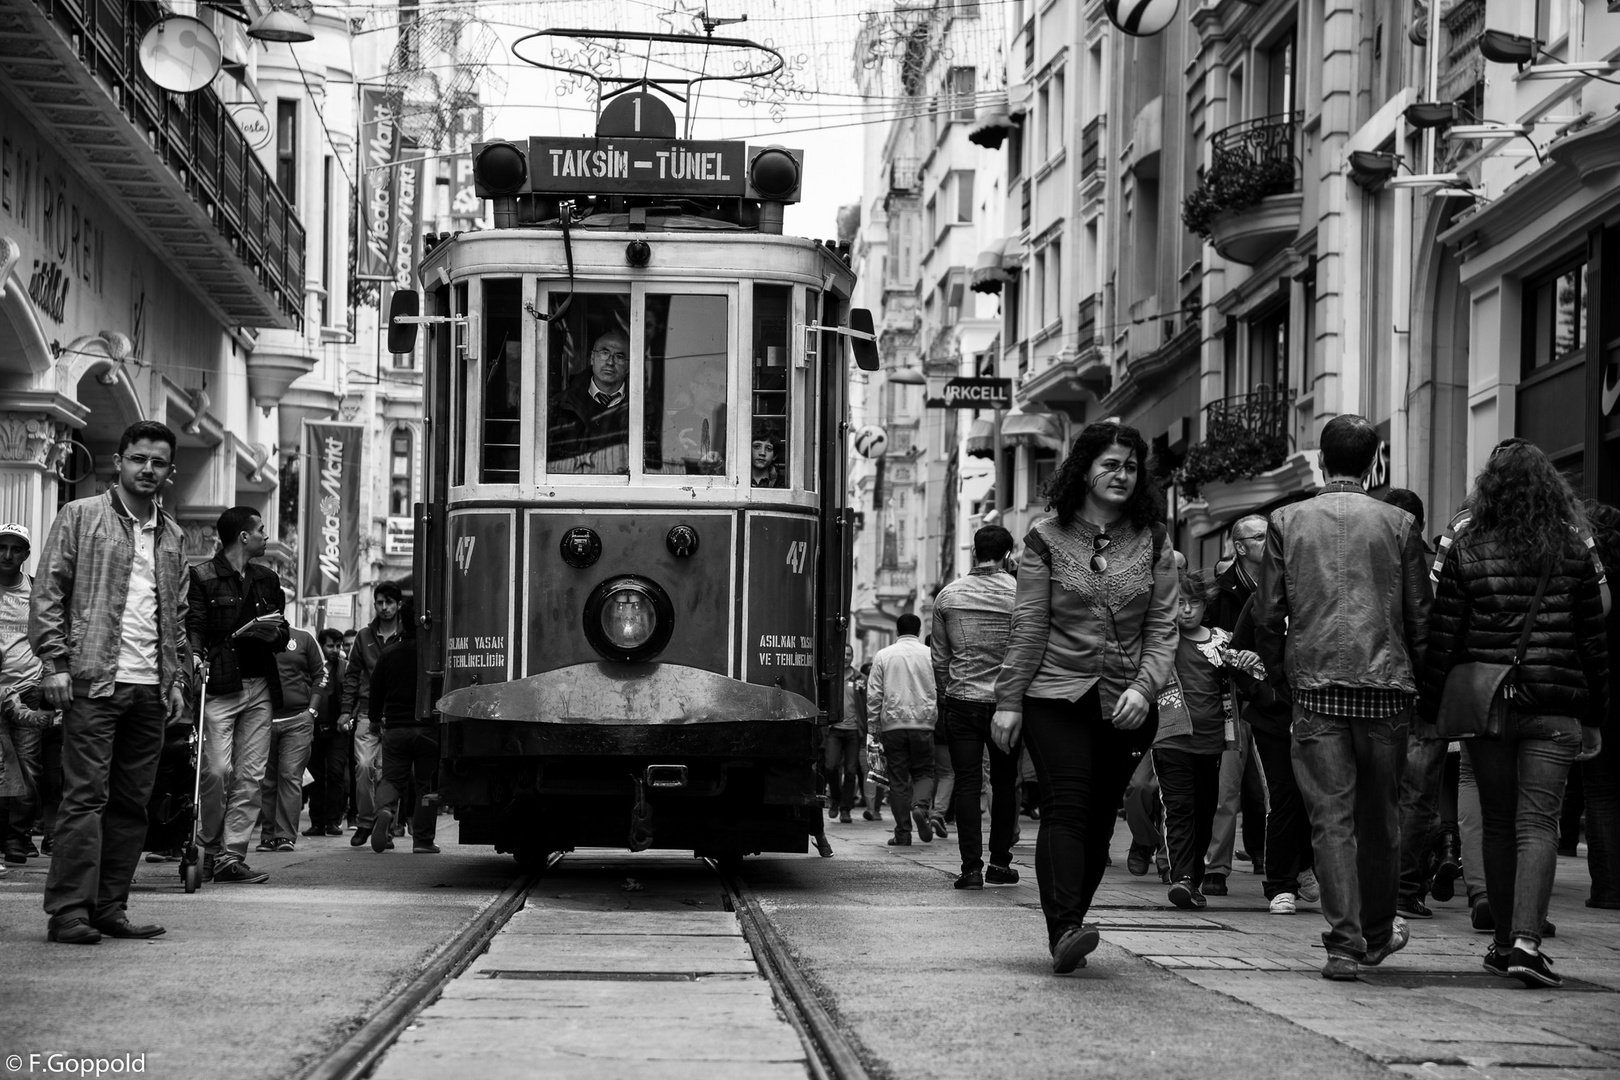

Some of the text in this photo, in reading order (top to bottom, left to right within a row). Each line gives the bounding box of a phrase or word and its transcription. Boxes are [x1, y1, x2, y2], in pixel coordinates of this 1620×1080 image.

[632, 97, 641, 132] 1
[549, 144, 629, 179] TAKSİM
[656, 146, 731, 181] TÜNEL
[390, 243, 413, 297] edia
[946, 385, 1008, 400] RKCELL
[318, 515, 340, 584] Media
[455, 536, 476, 571] 47
[786, 540, 807, 574] 47
[448, 636, 505, 650] SILMAK YASAK
[759, 634, 797, 649] ASILMAK
[759, 652, 772, 666] VE
